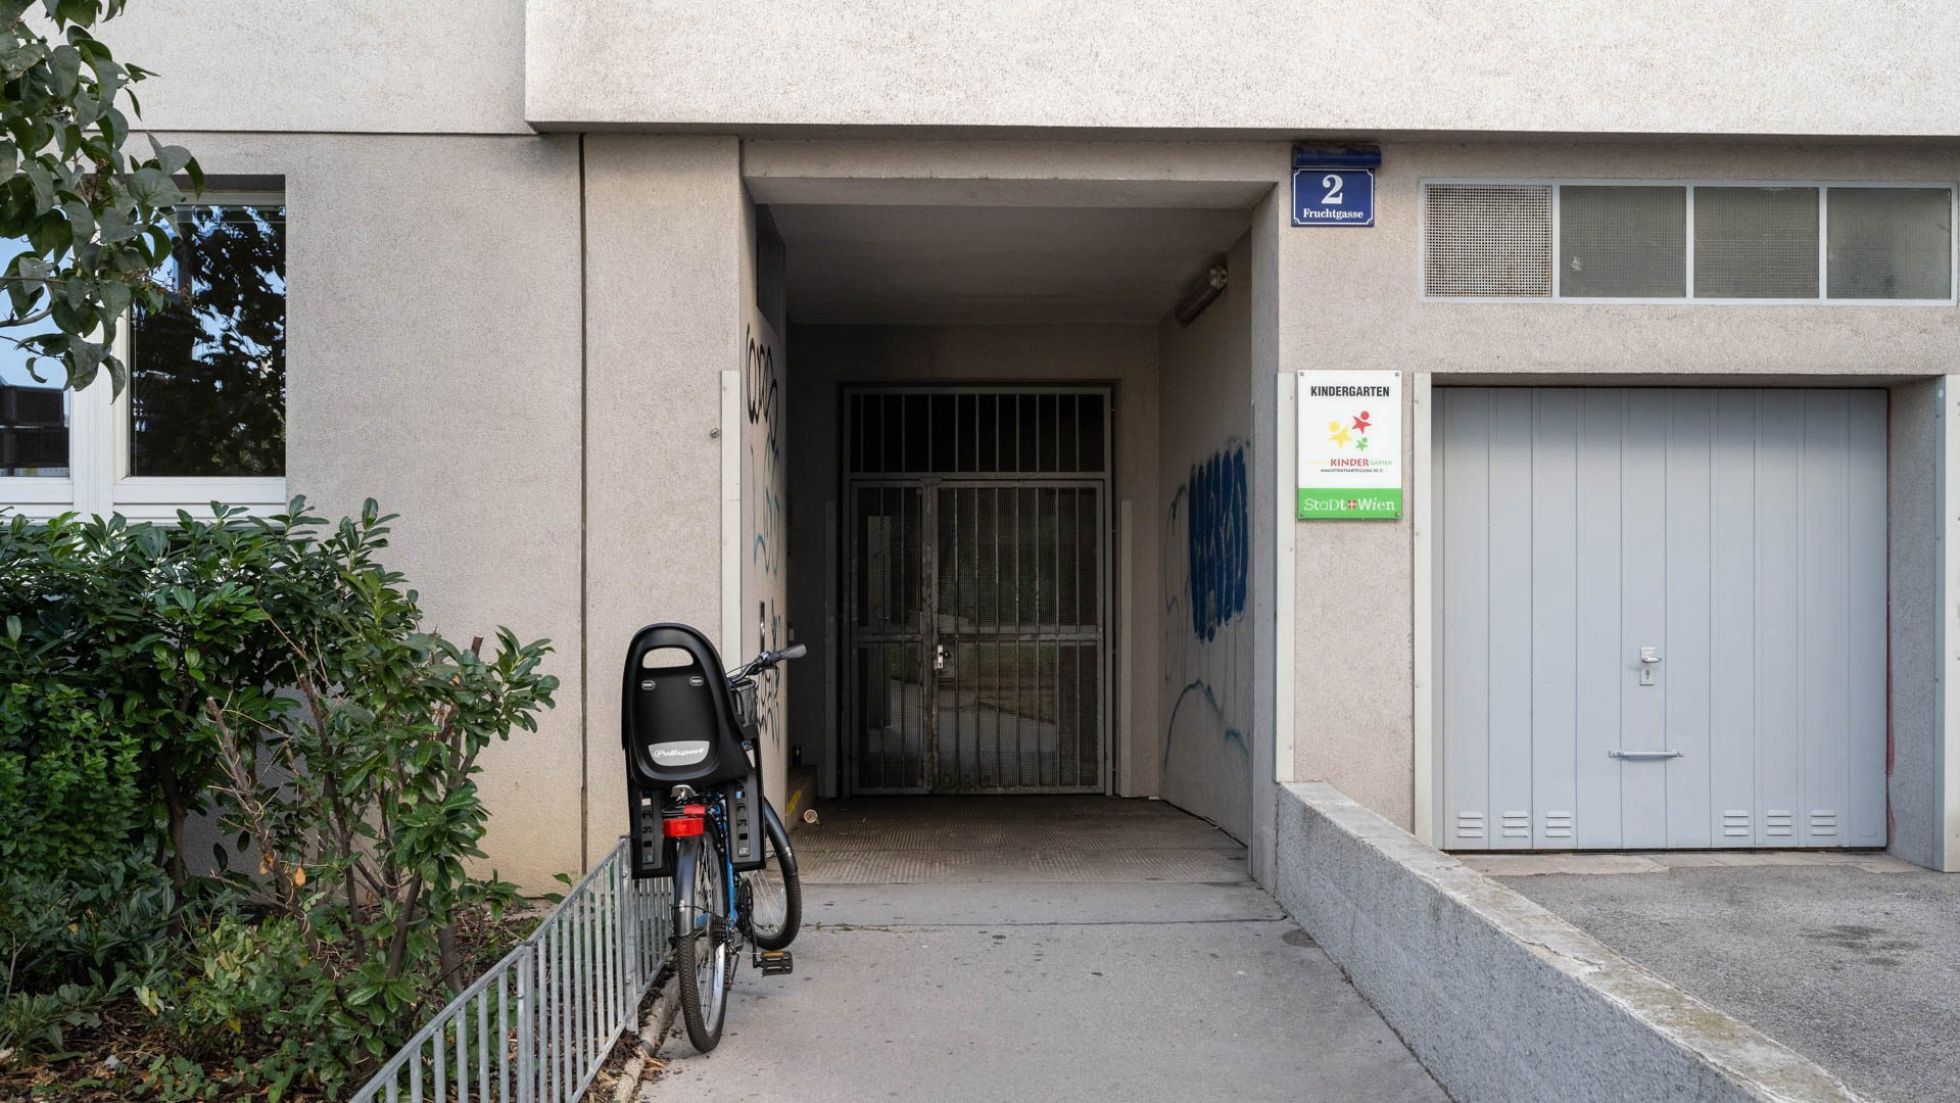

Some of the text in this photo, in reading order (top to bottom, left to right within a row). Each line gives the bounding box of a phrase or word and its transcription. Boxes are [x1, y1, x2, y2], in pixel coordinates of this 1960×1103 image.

[1321, 174, 1343, 204] 2
[1303, 208, 1364, 219] Fruchtgasse
[1310, 386, 1390, 397] KINDERGARTEN
[1330, 458, 1369, 466] KINDER
[1358, 497, 1395, 511] Wien
